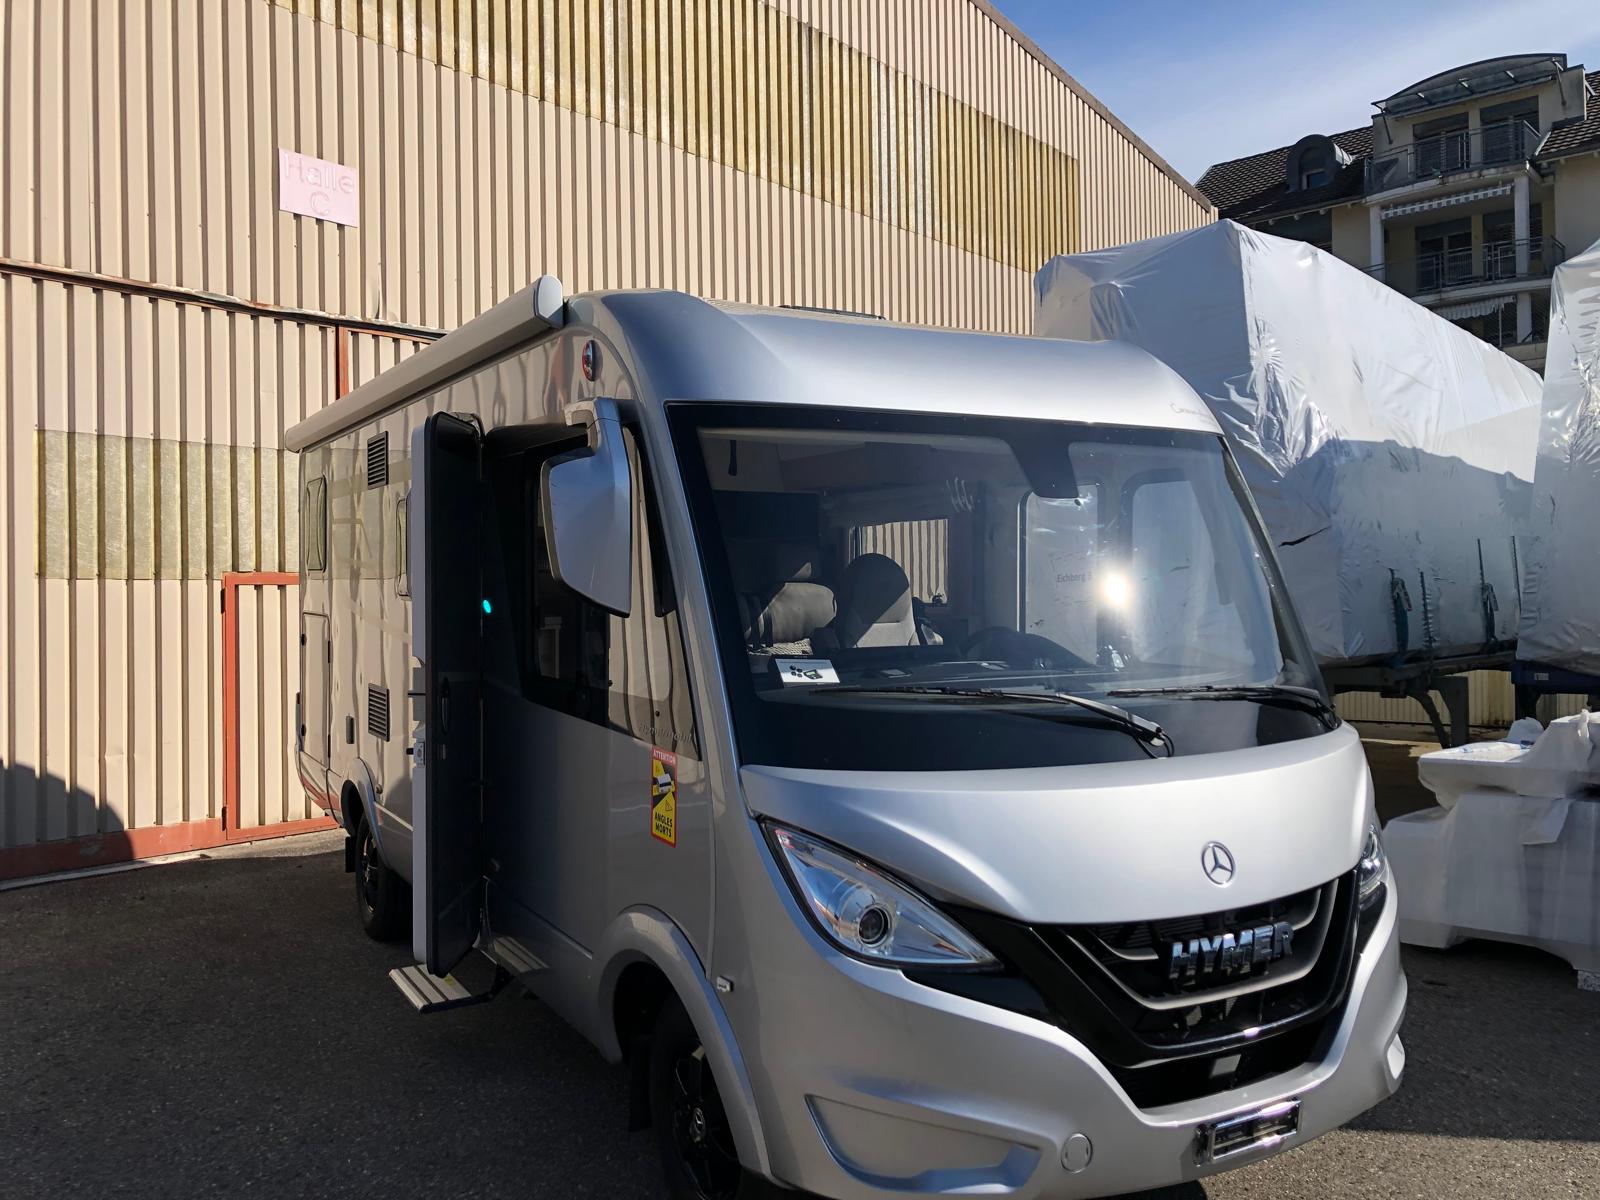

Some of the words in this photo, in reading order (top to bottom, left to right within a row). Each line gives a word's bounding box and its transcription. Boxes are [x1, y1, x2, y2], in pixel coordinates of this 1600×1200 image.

[284, 152, 354, 194] Halle
[310, 191, 330, 216] C
[653, 749, 676, 765] ATTENTION
[655, 811, 673, 827] ANGLES
[655, 822, 672, 837] MORTS
[1169, 921, 1294, 980] HYMER
